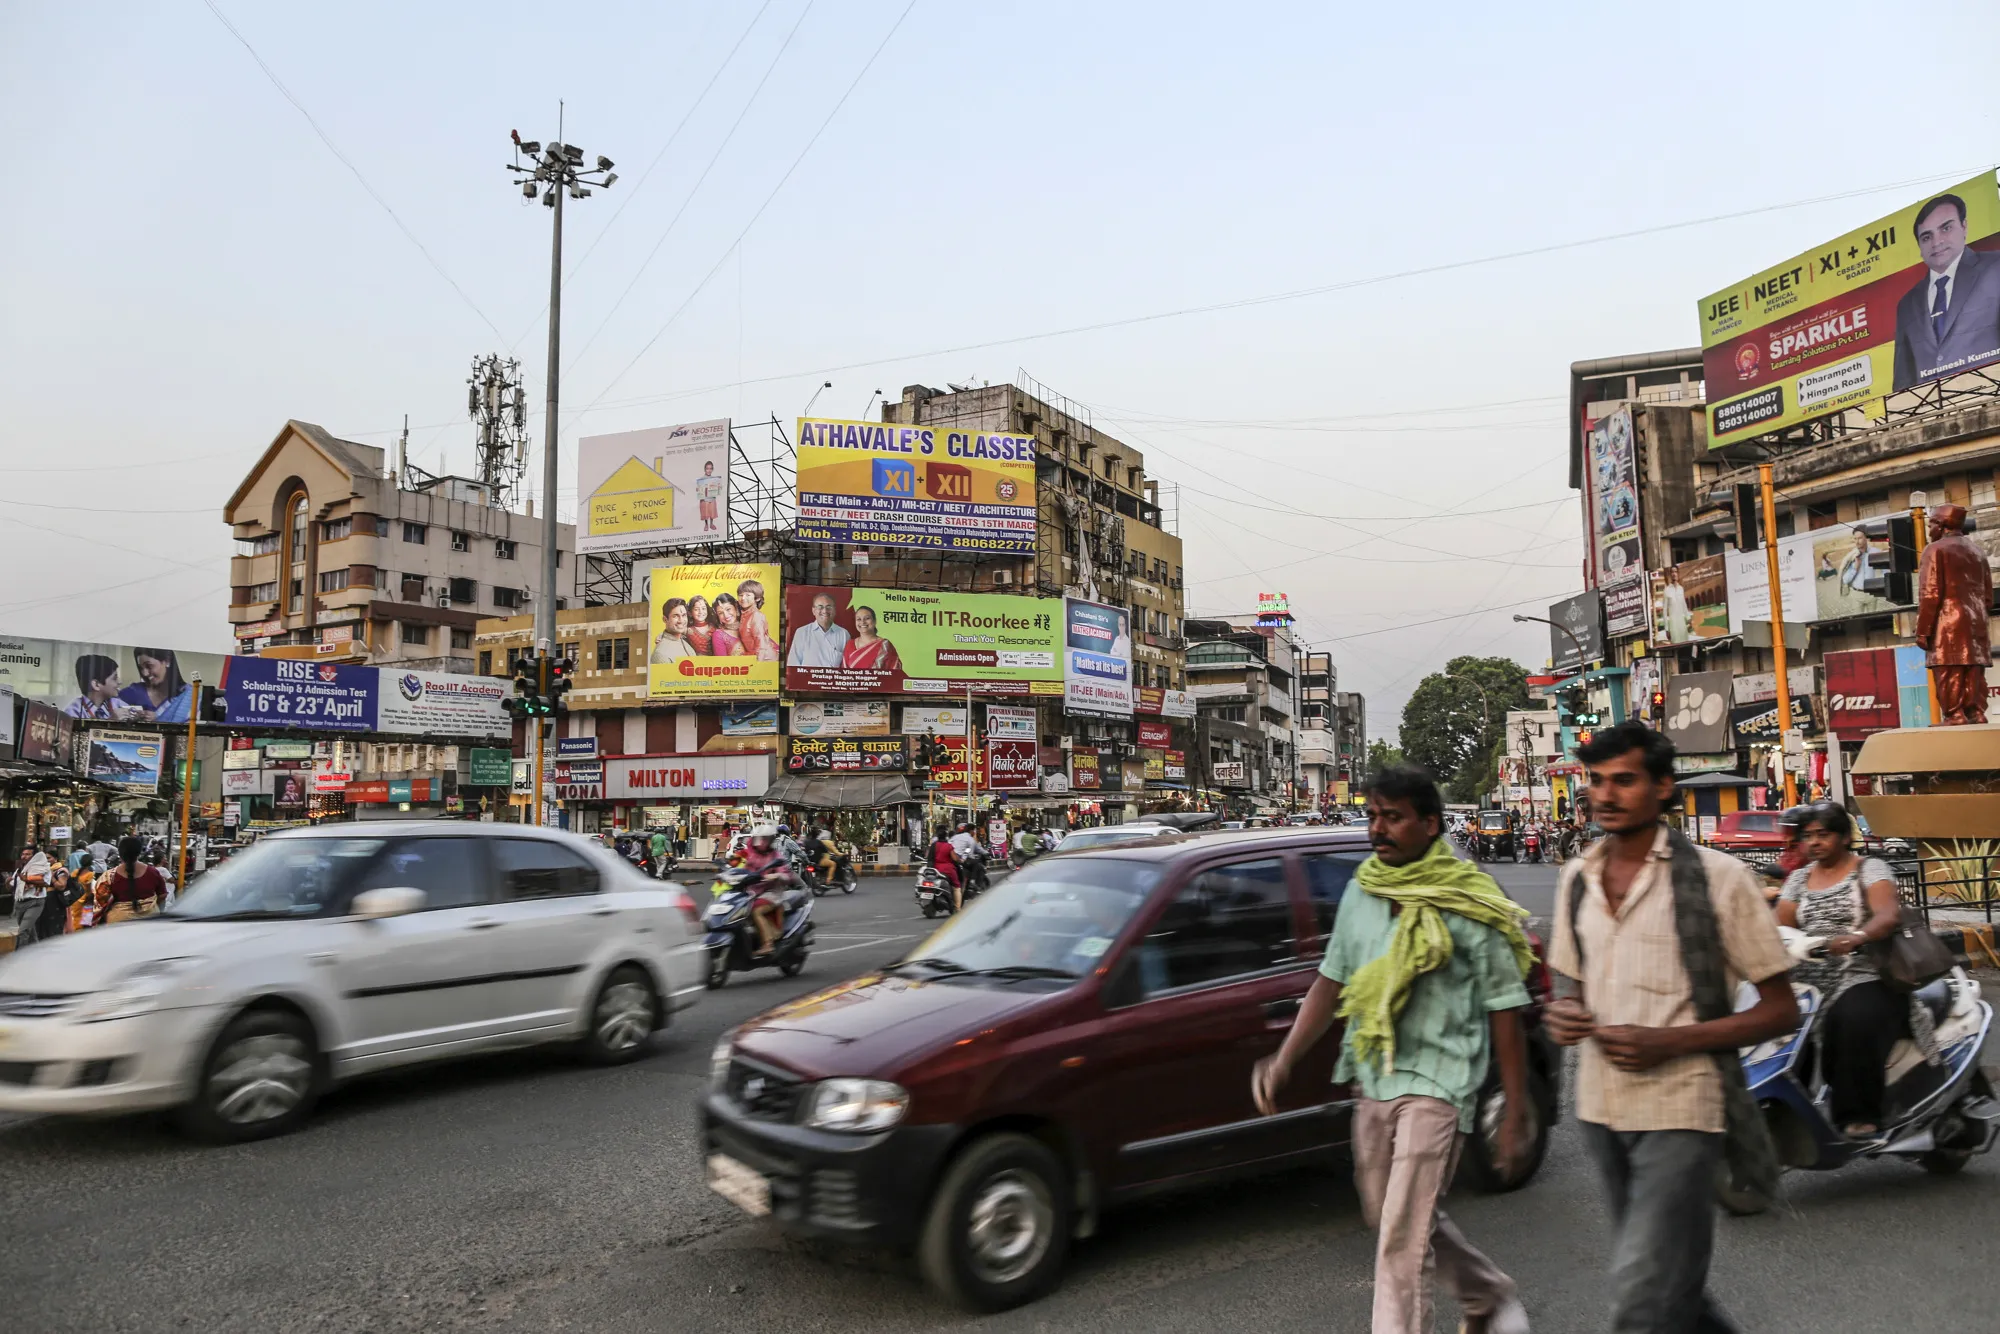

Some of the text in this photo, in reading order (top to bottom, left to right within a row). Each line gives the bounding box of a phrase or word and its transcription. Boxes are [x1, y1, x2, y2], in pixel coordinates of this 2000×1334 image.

[1708, 295, 1740, 321] JEE
[1753, 266, 1803, 302] NEET
[1819, 250, 1840, 275] XI
[1865, 226, 1896, 255] XII
[1845, 265, 1872, 281] BOARD
[1763, 295, 1798, 314] ENTRANCE
[1766, 290, 1794, 306] MEDICAL
[1711, 319, 1743, 336] ADVANCED
[1718, 316, 1734, 326] MAIN
[1769, 307, 1868, 360] SPARKLE
[1771, 353, 1802, 370] Learning
[1802, 342, 1837, 359] Solutions
[1806, 361, 1862, 387] Dharampeth
[1920, 358, 1965, 378] Karunesh
[1807, 374, 1866, 400] Hingna Road
[1718, 391, 1778, 419] 8806140007
[1807, 389, 1871, 413] PUNE NAGPUR
[1718, 404, 1778, 431] 9503140001
[668, 425, 724, 440] JSW NEOSTEEL
[884, 469, 969, 497] XI + XII
[1000, 485, 1014, 495] 25
[595, 503, 617, 514] PURE
[632, 498, 667, 510] STRONG
[802, 493, 1036, 517] IIT-JEE (Main Adv.) MH-CET NEET ARCHITECTURE
[595, 518, 620, 526] STEEL
[632, 512, 659, 522] HOMES
[801, 508, 838, 518] MH-CET
[847, 510, 871, 519] NEET
[873, 512, 904, 522] CRASH
[907, 514, 943, 524] COURSE
[944, 516, 979, 527] STARTS
[981, 519, 1004, 528] 15TH
[798, 528, 837, 539] Mob.
[851, 530, 948, 547] 8806822775,
[670, 565, 762, 589] Wedding Collection
[909, 595, 941, 605] Nagpur,
[883, 610, 909, 624] हमारा
[932, 610, 1030, 629] IIT-Roorkee
[1034, 614, 1043, 629] में
[954, 634, 1051, 646] Thank You Resonance
[1089, 628, 1112, 640] ACADEMY
[0, 642, 24, 650] edical
[0, 653, 41, 667] anning
[938, 652, 995, 663] Admissions Open
[277, 660, 315, 680] RISE
[678, 659, 749, 678] Gaysons
[1096, 659, 1102, 671] at
[1102, 660, 1111, 673] its
[242, 680, 367, 698] Scholarship & Admission Test
[425, 681, 445, 691] Rao
[446, 682, 460, 693] IIT
[460, 684, 505, 697] Academy
[694, 679, 714, 687] mall
[1070, 684, 1093, 696] IIT-JEE
[248, 693, 276, 713] 16th
[277, 694, 291, 714] &
[295, 696, 324, 715] 23rd
[323, 697, 363, 721] April
[561, 741, 593, 750] Panasonic
[792, 737, 902, 754] हेल्मेट सेल बाजार
[571, 773, 600, 782] Whirlpool
[629, 768, 747, 790] MILTON DRESSES
[556, 785, 600, 799] MONA
